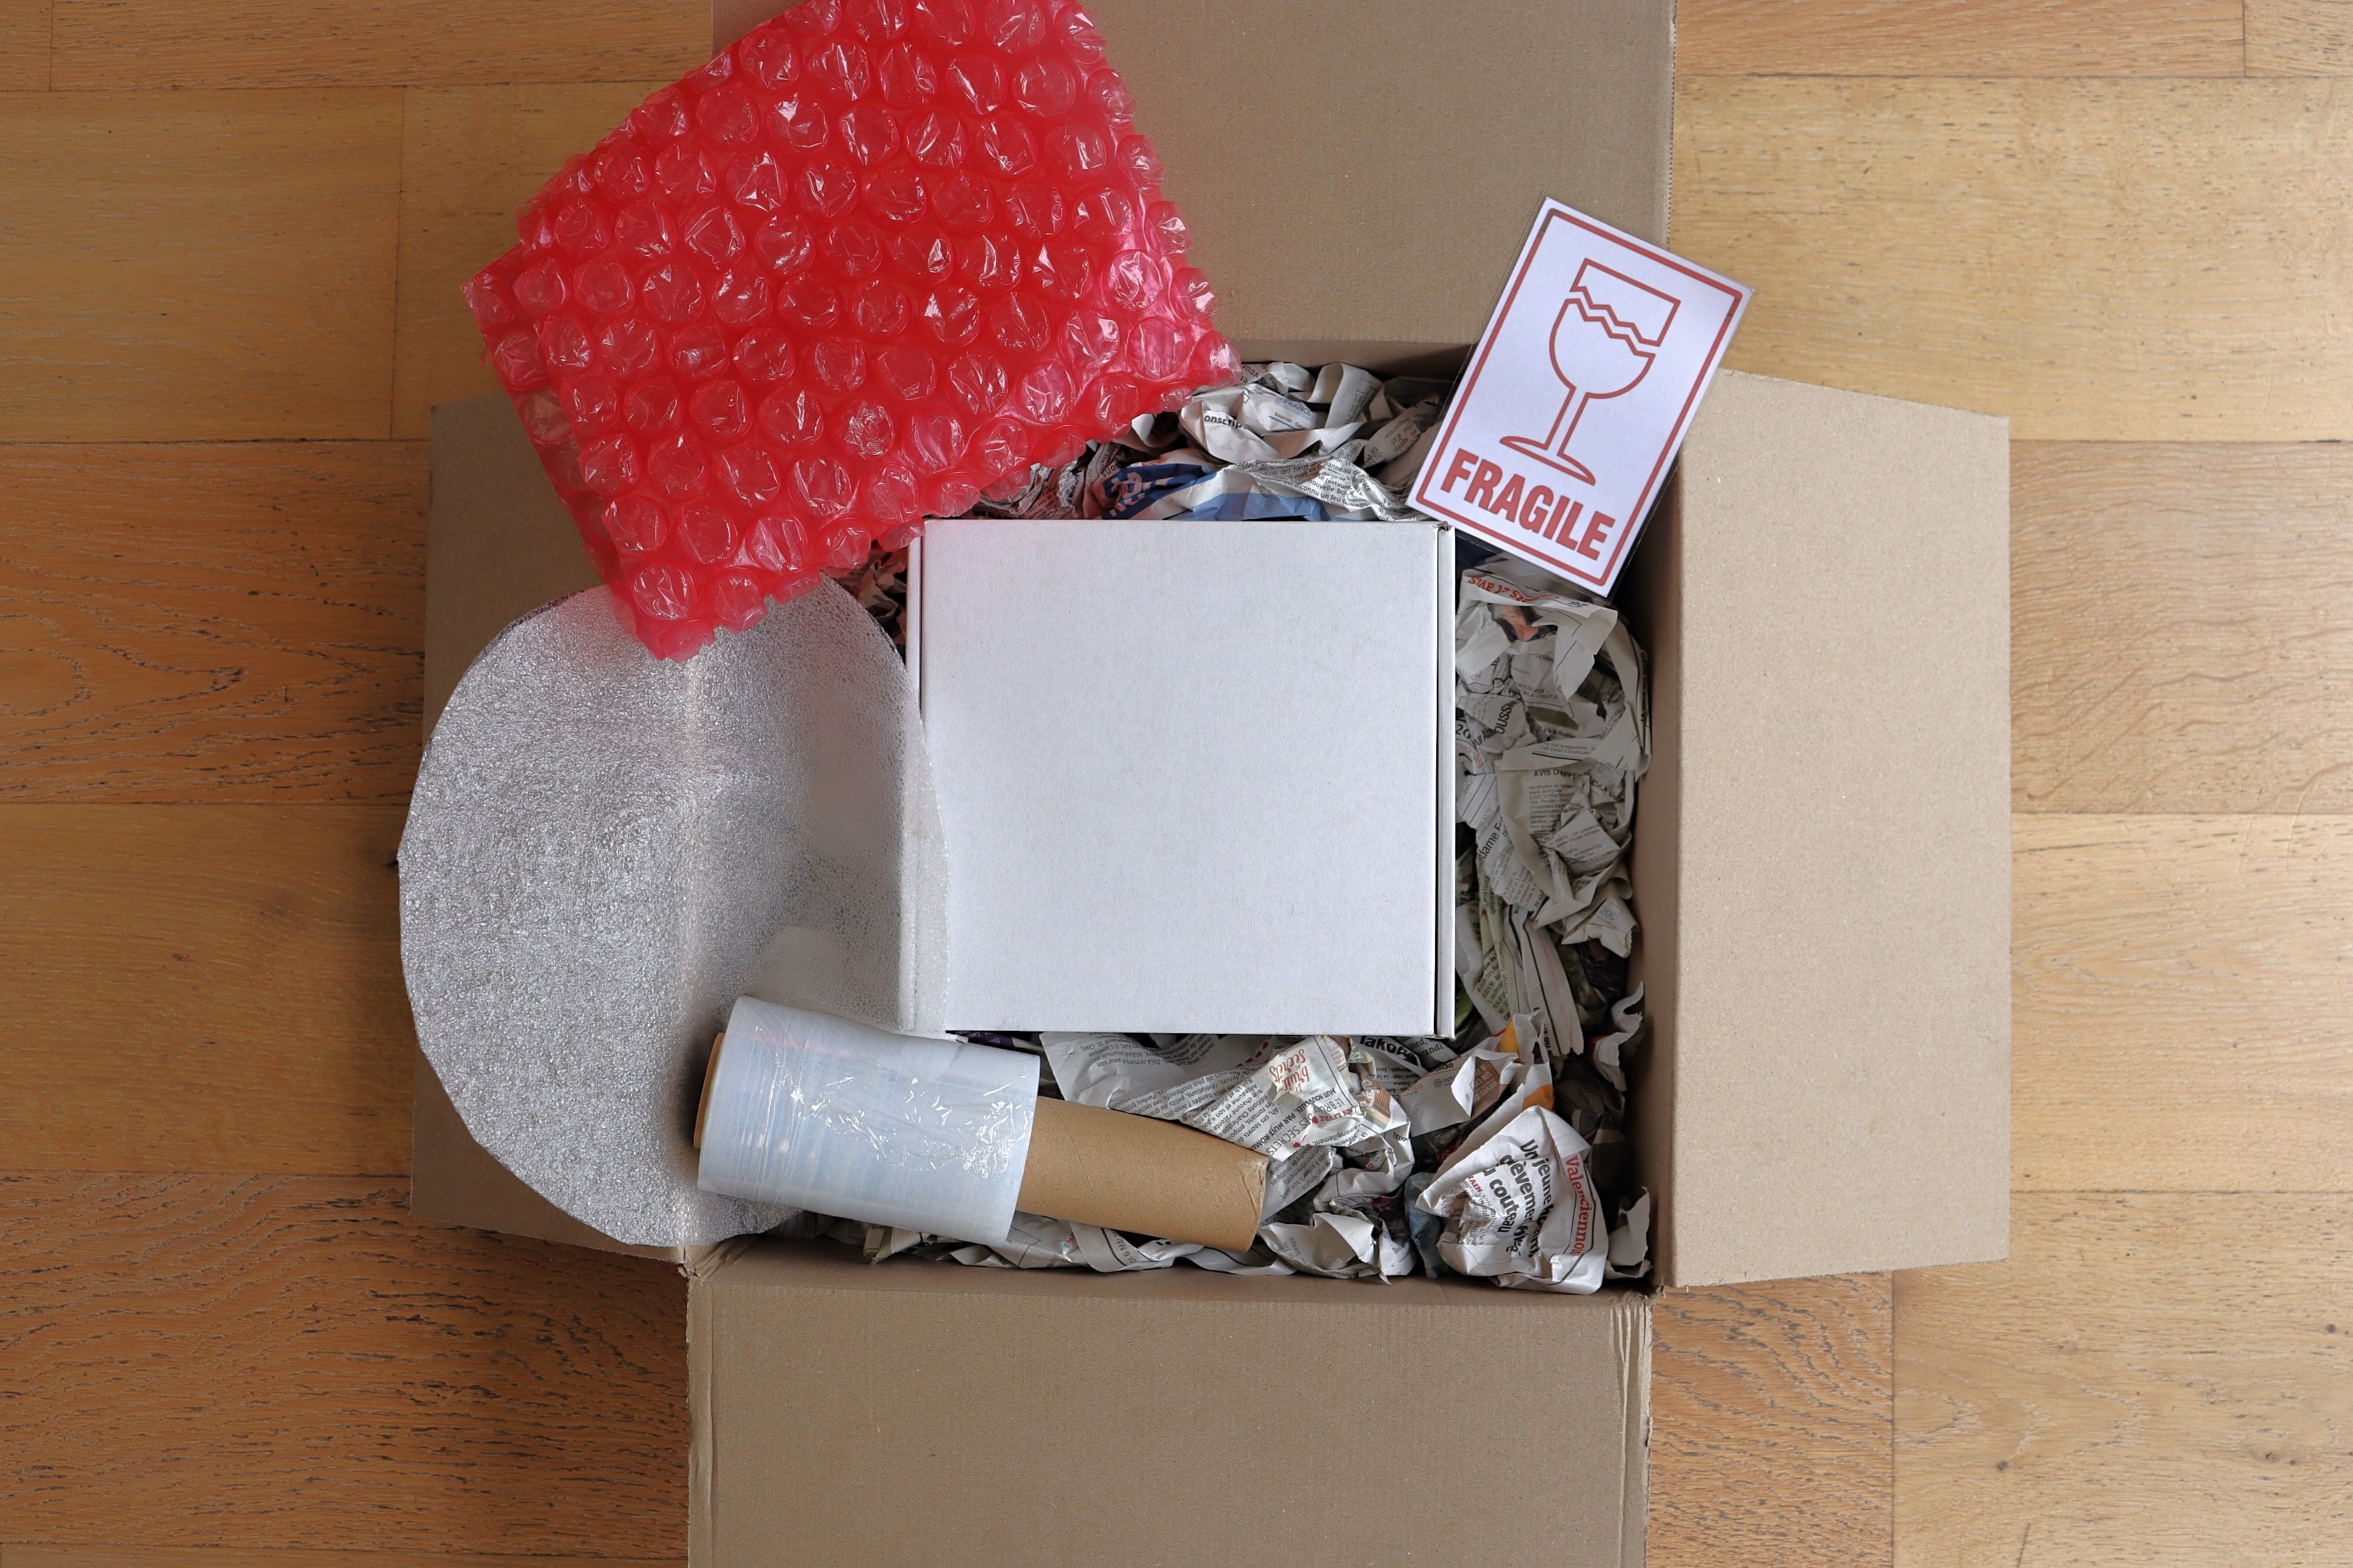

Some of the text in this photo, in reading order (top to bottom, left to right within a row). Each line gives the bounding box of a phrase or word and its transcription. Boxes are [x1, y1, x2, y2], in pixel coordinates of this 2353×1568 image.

[1282, 399, 1312, 416] FRANCE
[1323, 461, 1351, 474] panneau
[1299, 483, 1319, 496] connu
[1329, 493, 1342, 503] feu
[1308, 478, 1335, 492] nouvelle
[1441, 448, 1617, 561] FRAGILE
[1267, 1047, 1308, 1085] secrets
[1192, 1077, 1204, 1086] plus
[1280, 1066, 1311, 1092] bruit
[1136, 1093, 1156, 1104] Parfois
[1227, 1090, 1235, 1098] et
[1231, 1083, 1258, 1106] Anseaume
[1322, 1087, 1336, 1099] HUIT
[1208, 1096, 1227, 1112] Juliette,
[1212, 1087, 1262, 1131] que chacune raconte
[1264, 1100, 1274, 1110] les
[1293, 1092, 1325, 1113] NOUVELLES,
[1334, 1097, 1345, 1108] LE
[1202, 1110, 1209, 1119] la
[1215, 1107, 1225, 1117] son
[1221, 1095, 1269, 1135] éditions Charleston
[1244, 1106, 1266, 1125] romans,
[1259, 1114, 1269, 1125] ces
[1268, 1106, 1279, 1117] Ah,
[1284, 1112, 1296, 1123] PAR
[1242, 1121, 1262, 1139] secrets
[1268, 1119, 1287, 1139] HUIT
[1265, 1124, 1303, 1156] SECRETS
[1532, 1158, 1552, 1202] jeune
[1489, 1177, 1515, 1233] couteau
[1116, 1236, 1125, 1251] MAI
